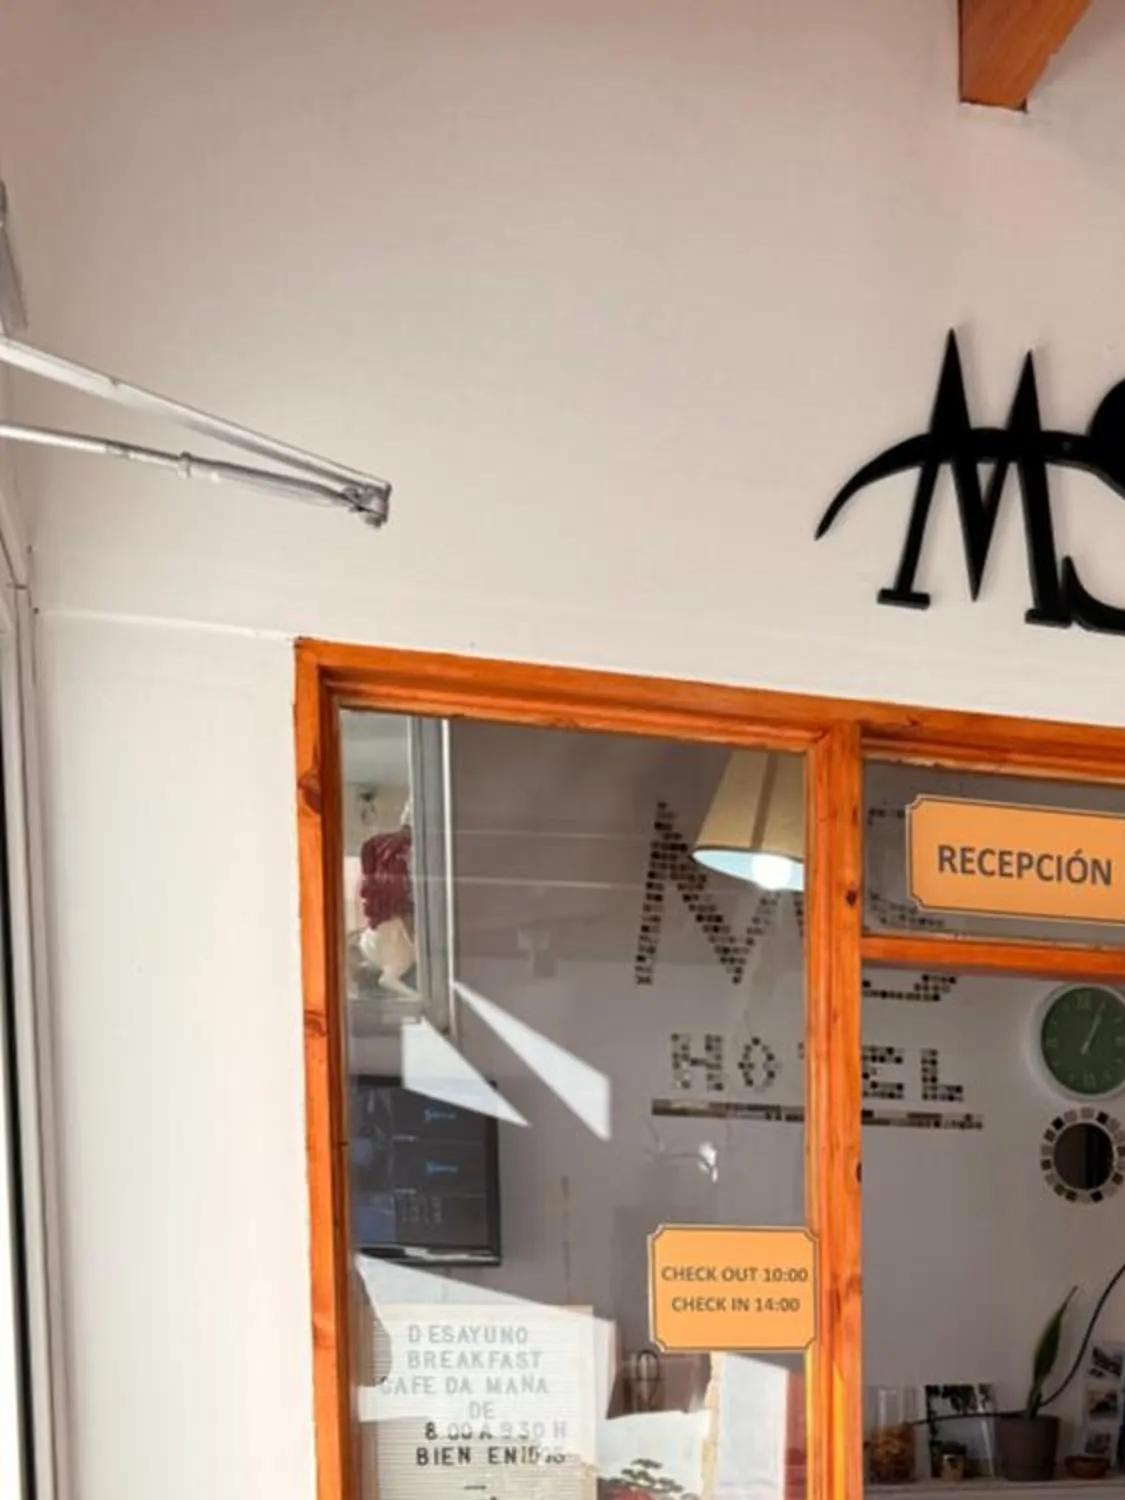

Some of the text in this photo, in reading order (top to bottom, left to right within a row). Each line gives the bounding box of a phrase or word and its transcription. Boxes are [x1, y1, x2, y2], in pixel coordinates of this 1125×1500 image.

[937, 844, 1112, 887] RECEPCIÓN
[668, 1031, 965, 1103] HOEL
[661, 1265, 809, 1283] CHECK OUT 10:00
[672, 1296, 801, 1313] CHECK IN 14:00
[406, 1350, 544, 1370] BREAKFAST
[445, 1376, 473, 1395] DA
[469, 1401, 495, 1420] DE
[415, 1447, 471, 1467] BIEN
